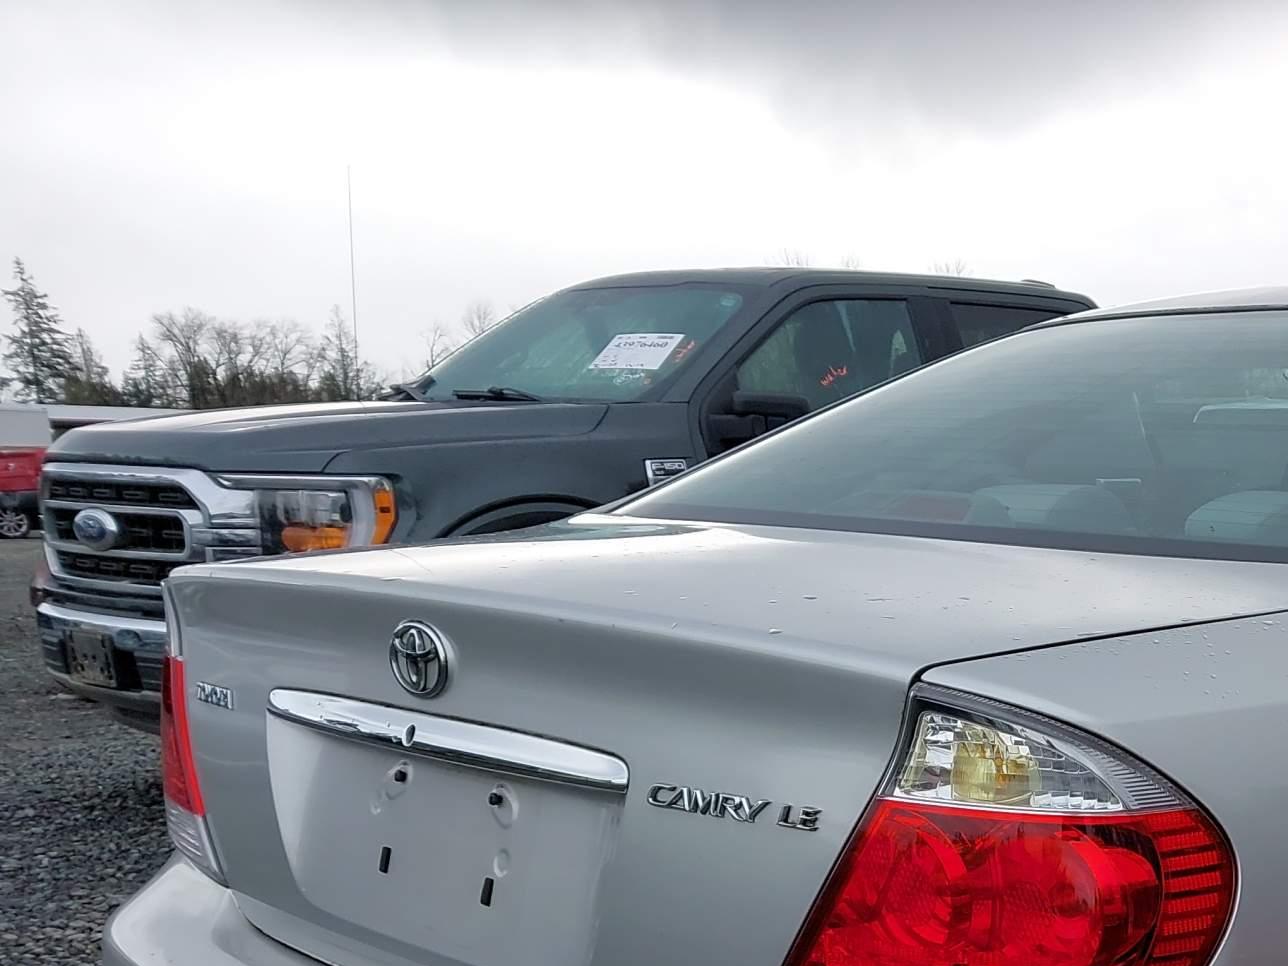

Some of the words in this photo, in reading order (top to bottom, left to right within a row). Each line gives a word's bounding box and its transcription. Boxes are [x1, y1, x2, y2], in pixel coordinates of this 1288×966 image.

[651, 462, 685, 471] F-150
[646, 782, 773, 824] CAMRY
[775, 803, 823, 832] LE
